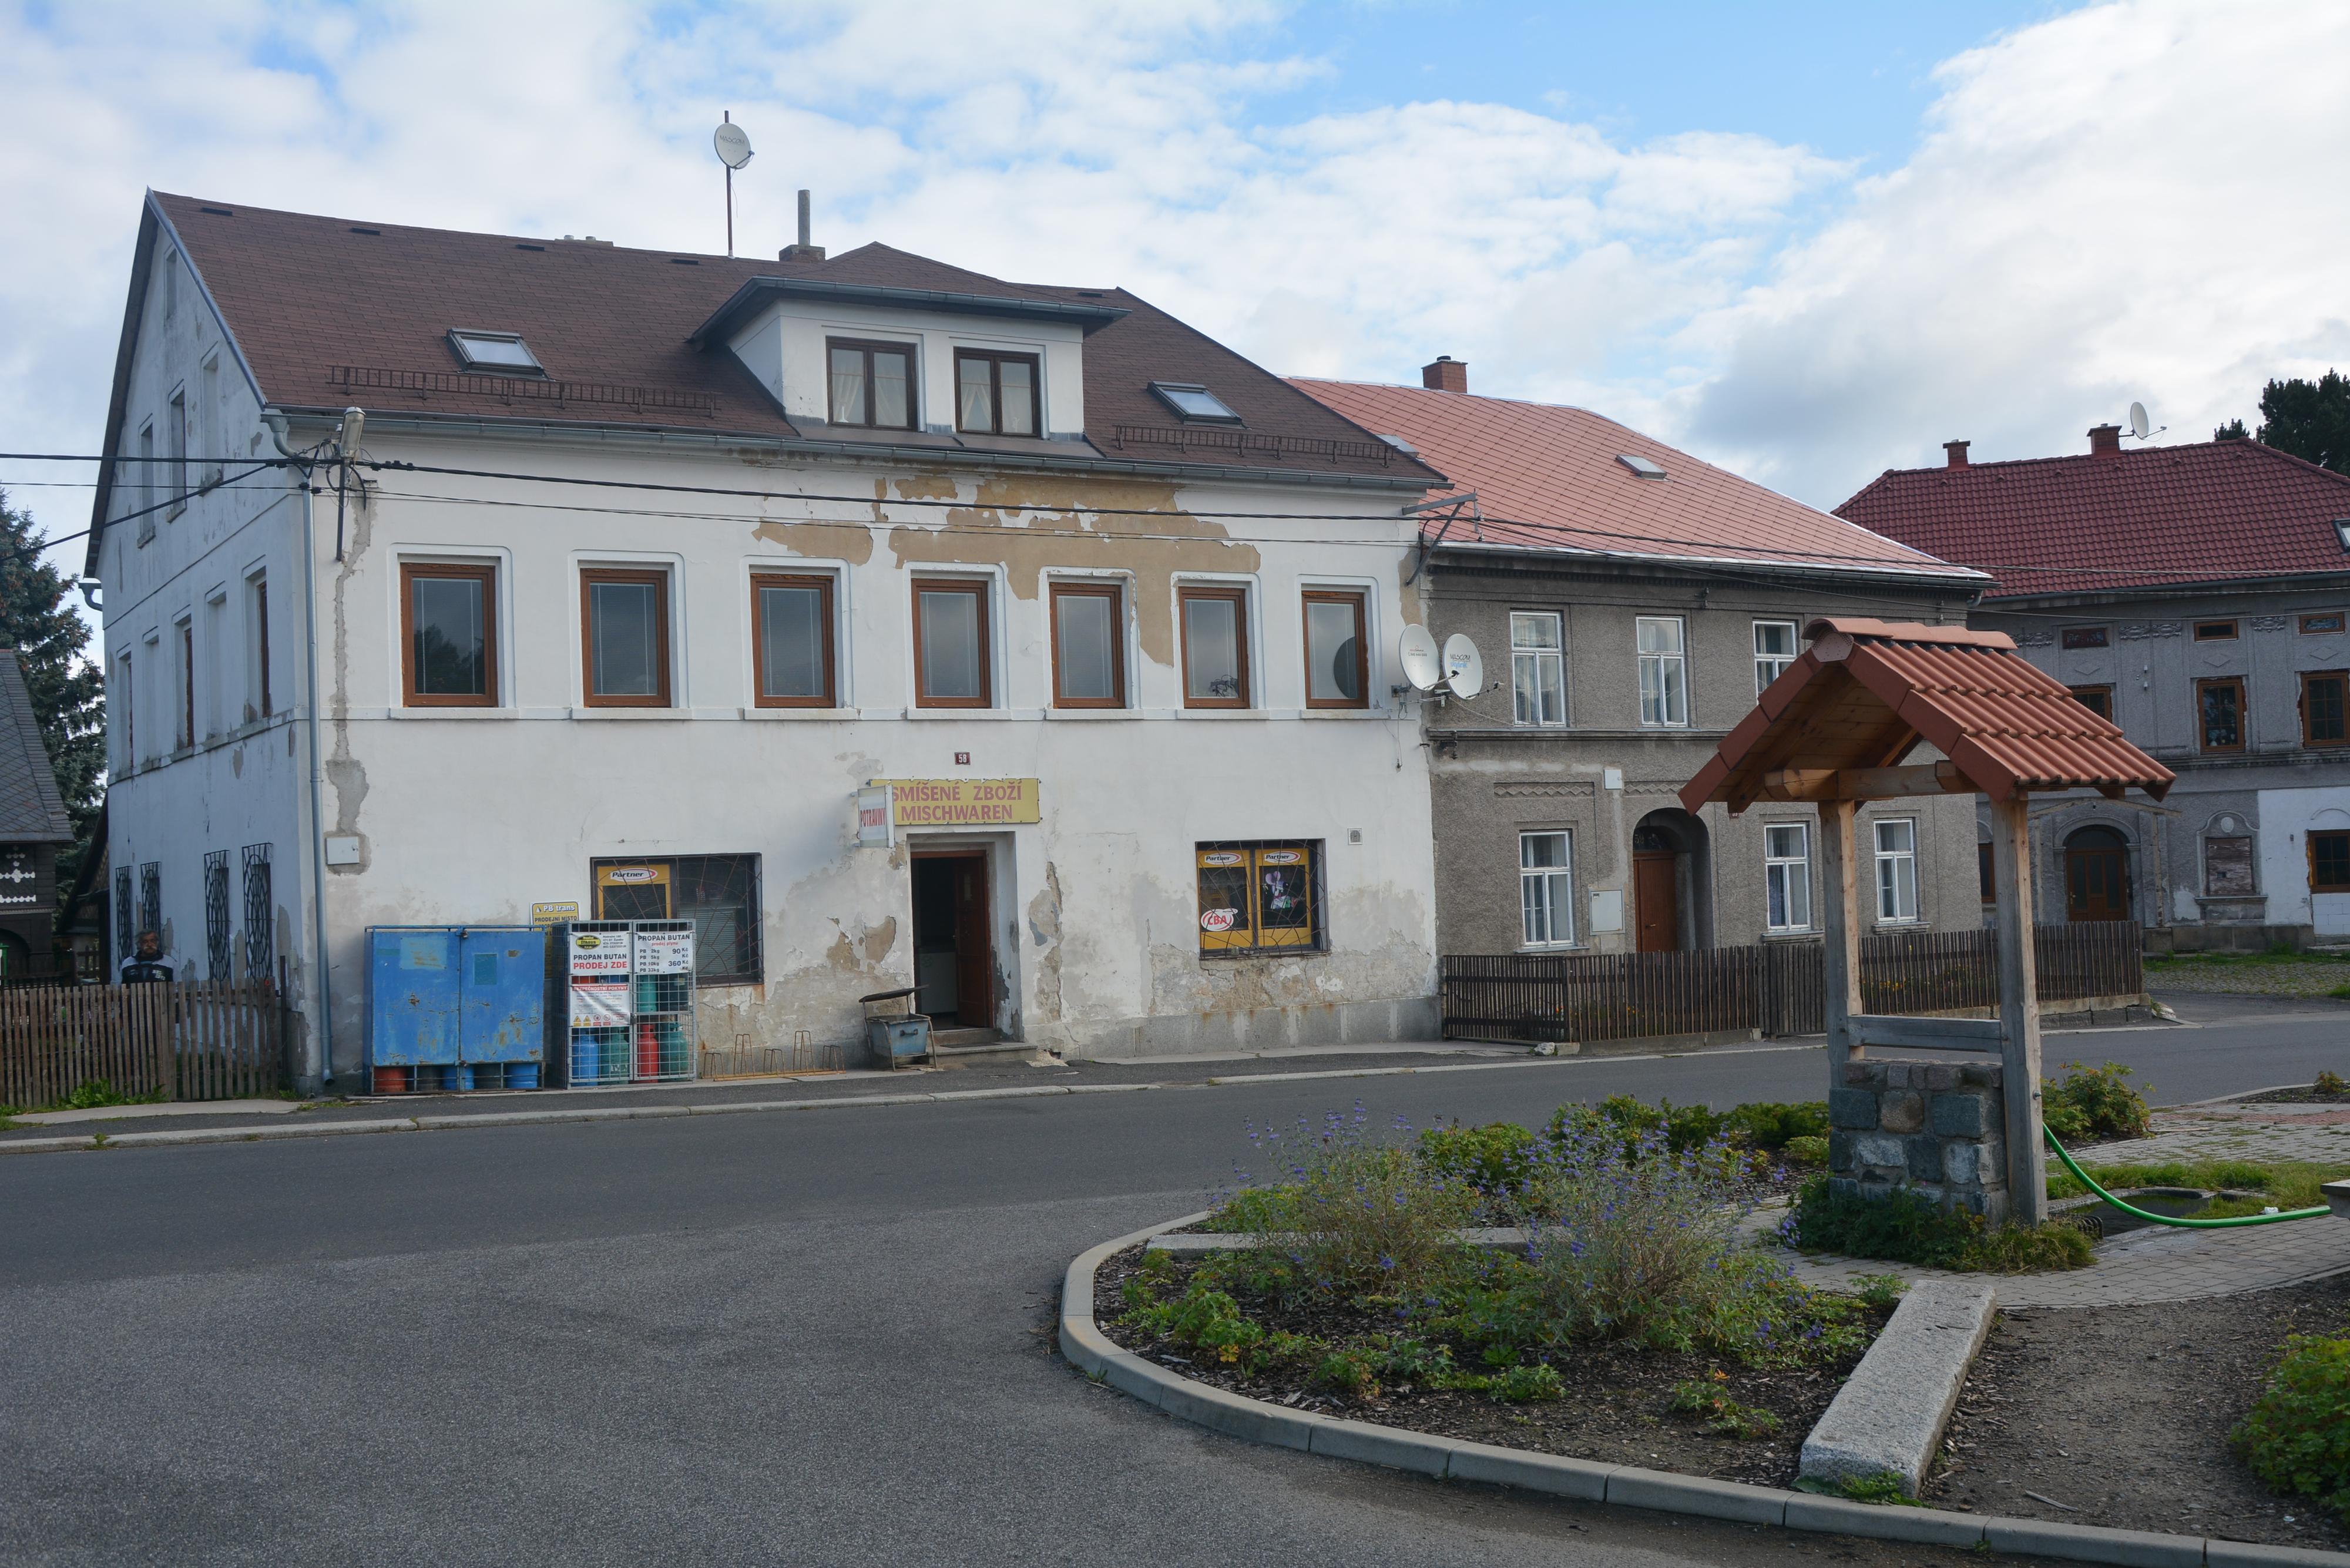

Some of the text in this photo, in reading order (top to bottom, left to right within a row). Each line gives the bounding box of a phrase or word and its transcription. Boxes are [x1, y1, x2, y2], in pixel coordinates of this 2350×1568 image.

[959, 754, 967, 763] 58
[892, 781, 1022, 801] SMÍŠENÉ ZBOŽÍ
[860, 808, 885, 828] POTRAVINY
[901, 805, 1013, 821] MISCHWAREN
[1207, 915, 1227, 926] CBA
